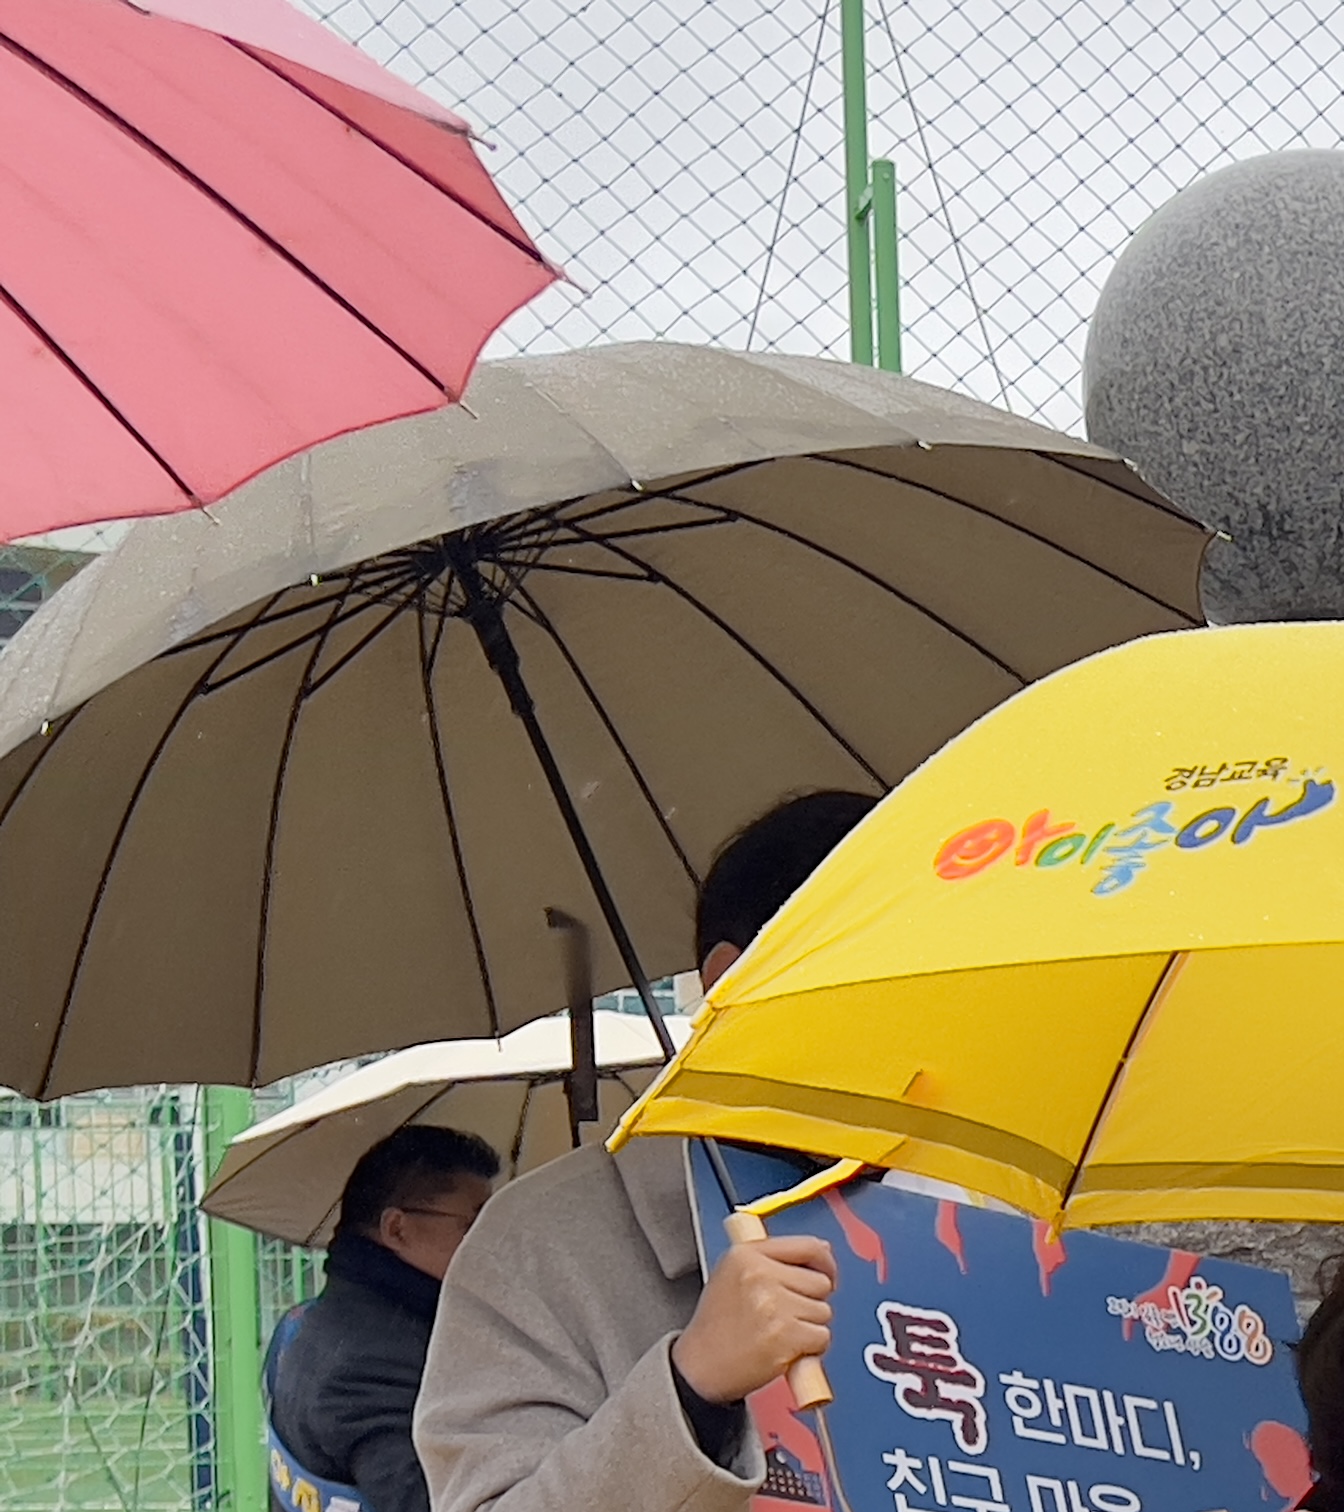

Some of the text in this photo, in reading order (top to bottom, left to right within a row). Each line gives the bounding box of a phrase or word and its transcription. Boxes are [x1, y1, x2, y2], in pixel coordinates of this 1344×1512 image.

[1164, 757, 1289, 791] 경남교육
[934, 779, 1335, 896] 아이좋아
[1164, 1277, 1273, 1364] 1388
[999, 1370, 1202, 1472] 한마디,
